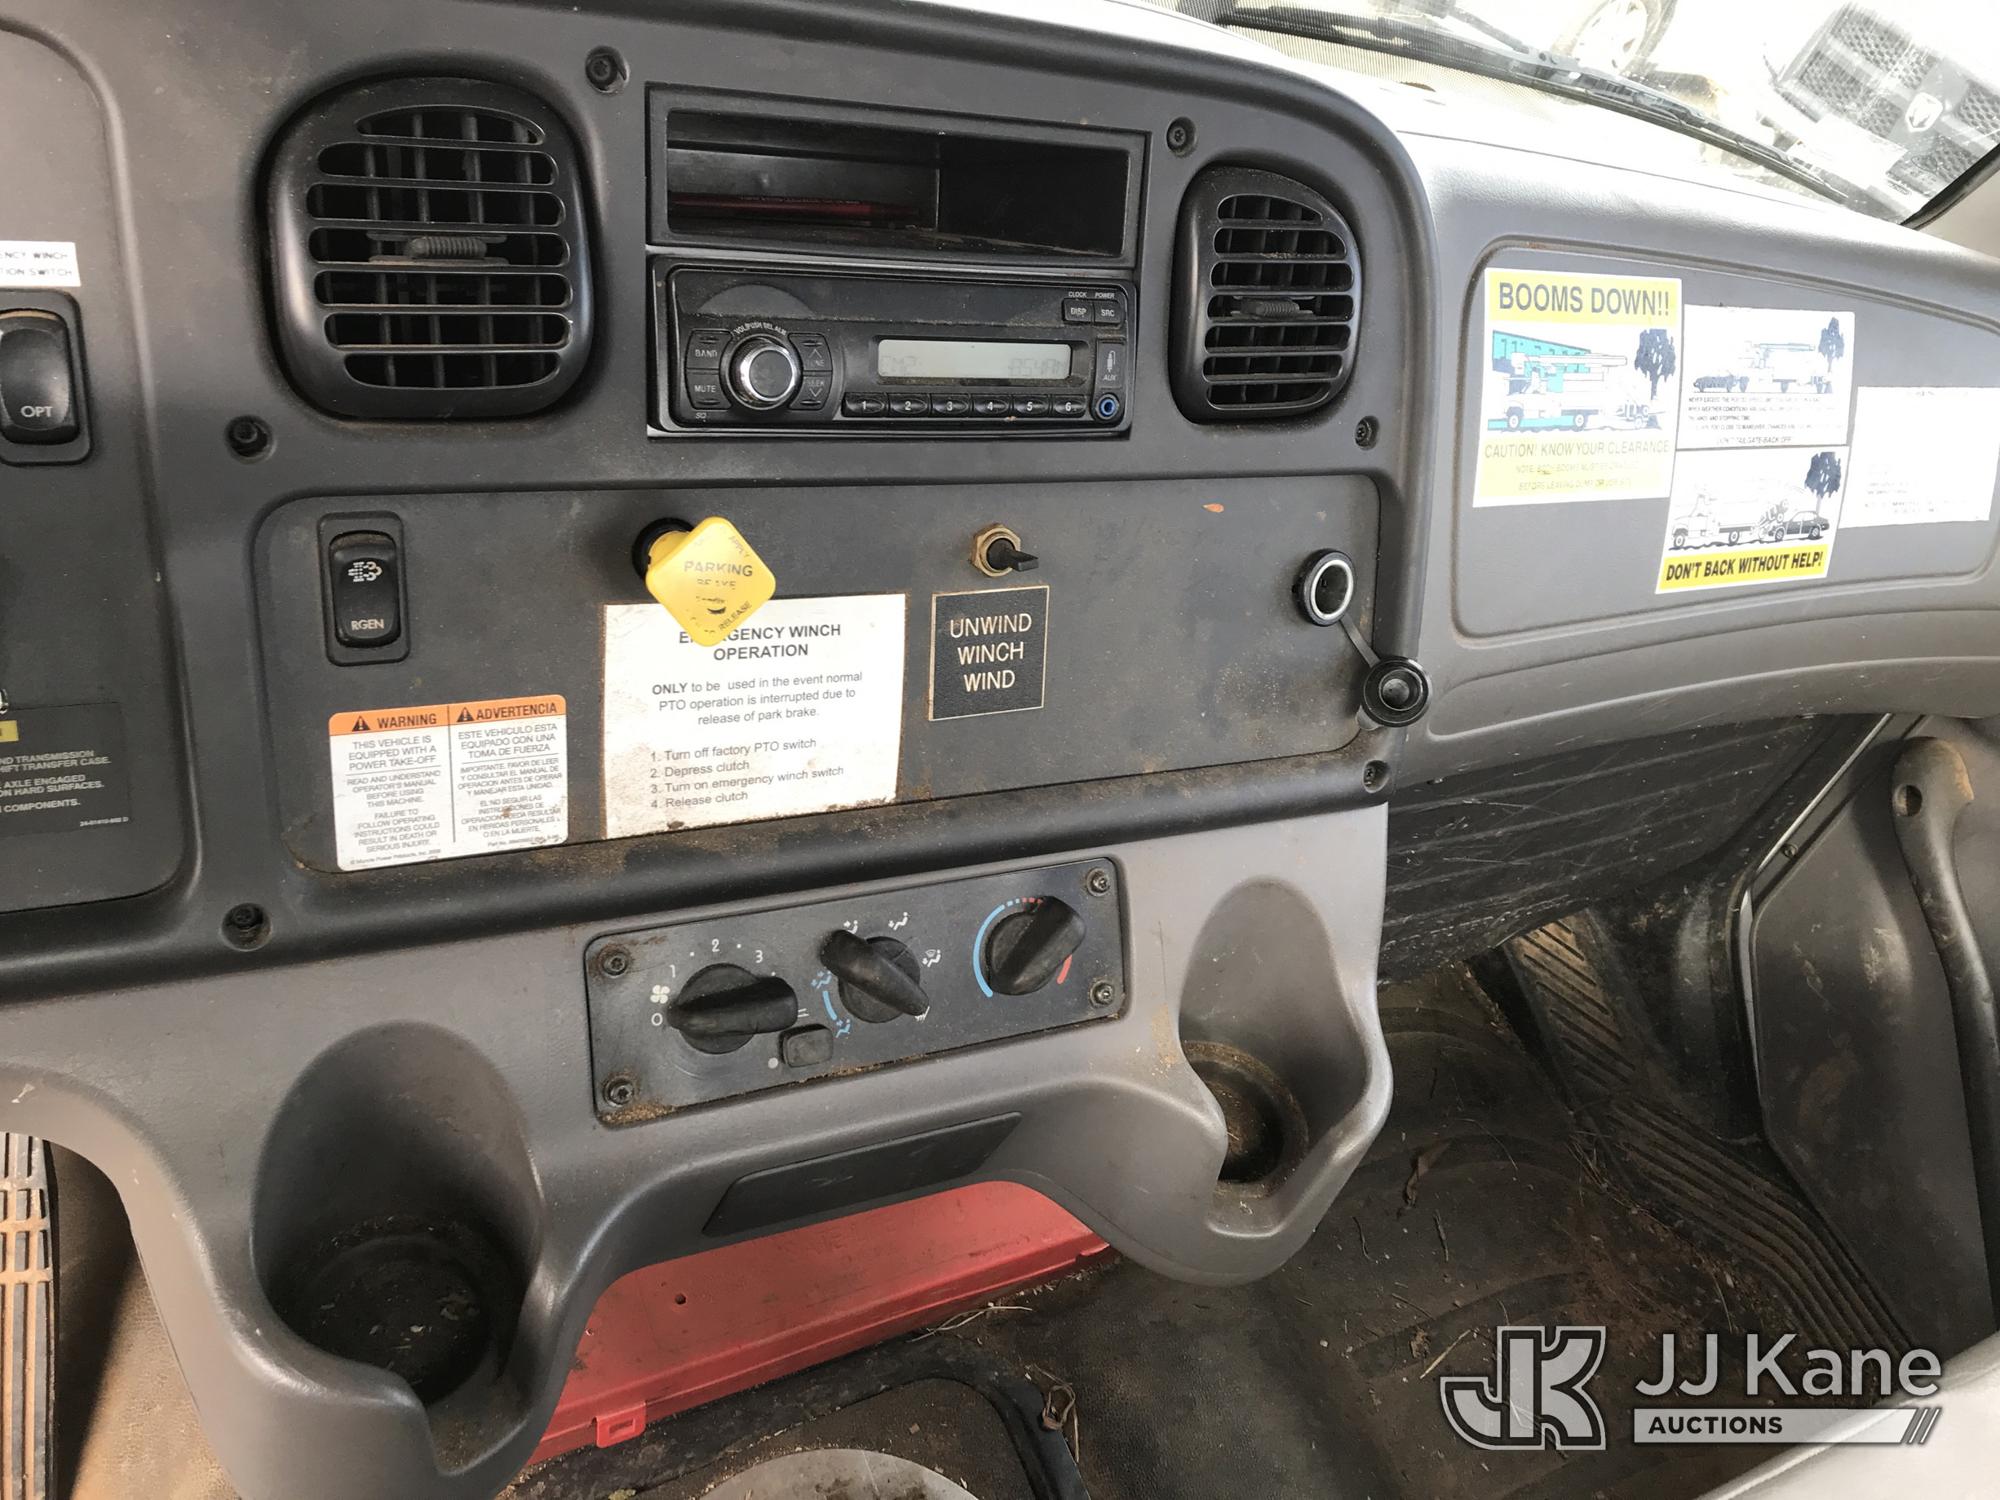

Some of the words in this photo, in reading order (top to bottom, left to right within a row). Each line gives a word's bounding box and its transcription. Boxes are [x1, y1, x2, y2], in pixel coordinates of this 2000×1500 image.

[1500, 282, 1583, 313] BOOMS
[1592, 287, 1669, 316] DOWN!!
[1071, 307, 1087, 315] DISP
[695, 350, 718, 358] BAND
[695, 385, 717, 393] MUTE
[21, 405, 53, 418] OPT
[1541, 443, 1574, 457] KNOW
[1576, 442, 1605, 456] YOUR
[685, 561, 753, 577] PARKING
[1666, 562, 1702, 581] DON'T
[1704, 558, 1736, 577] BACK
[1736, 554, 1790, 575] WITHOUT
[1791, 551, 1823, 570] HELP!
[719, 601, 752, 631] RELEASE
[352, 619, 384, 631] RGEN
[950, 613, 1032, 639] UNWIND
[679, 627, 785, 645] EGENCY
[789, 624, 842, 639] WINCH
[713, 644, 809, 661] OPERATION
[958, 641, 1024, 666] WINCH
[652, 682, 688, 696] ONLY
[692, 682, 703, 693] to
[706, 680, 721, 692] be
[728, 679, 755, 690] used
[759, 678, 769, 688] in
[773, 677, 790, 687] the
[793, 674, 823, 686] event
[826, 672, 863, 684] normal
[964, 670, 1016, 693] WIND
[659, 700, 686, 712] PTO
[690, 696, 744, 713] operation
[748, 695, 757, 706] is
[760, 690, 820, 706] interrupted
[823, 689, 843, 701] due
[846, 688, 856, 699] to
[477, 702, 558, 720] ADVERTENCIA
[698, 713, 741, 726] release
[744, 711, 755, 722] of
[758, 709, 783, 724] park
[786, 706, 820, 719] brake.
[377, 714, 437, 729] WARNING
[458, 730, 483, 740] ESTE
[484, 726, 533, 738] VEHICULO
[535, 723, 558, 733] ESTA
[353, 740, 376, 750] THIS
[378, 736, 420, 747] VEHICLE
[422, 735, 432, 743] IS
[461, 738, 511, 750] EQUIPADO
[512, 735, 534, 745] CON
[536, 733, 556, 742] UNA
[16, 750, 94, 764] TRANSMISSION
[349, 749, 400, 761] EQUIPPED
[402, 746, 427, 755] WITH
[429, 745, 437, 753] A
[468, 749, 497, 759] TOMA
[499, 748, 512, 756] DE
[513, 743, 551, 755] FUERZA
[651, 753, 661, 763] 1.
[665, 750, 691, 762] Turn
[695, 747, 710, 759] off
[712, 745, 751, 759] factory
[754, 741, 780, 753] PTO
[783, 738, 817, 751] switch
[23, 759, 79, 771] TRANSFER
[80, 757, 112, 766] CASE.
[349, 760, 387, 771] POWER
[389, 755, 437, 767] TAKE-OFF
[507, 761, 530, 769] FAVOR
[520, 766, 548, 775] MANUAL
[651, 769, 661, 779] 2.
[665, 762, 713, 779] Depress
[716, 760, 750, 773] clutch
[4, 779, 32, 789] AXLE
[34, 774, 86, 786] ENGAGED
[347, 778, 369, 786] READ
[389, 770, 441, 781] UNDERSTAND
[500, 777, 523, 785] ANTES
[651, 785, 662, 794] 3.
[665, 782, 691, 793] Turn
[695, 781, 709, 790] on
[712, 774, 774, 789] emergency
[778, 769, 809, 782] winch
[812, 766, 845, 779] switch
[14, 786, 45, 796] HARD
[47, 781, 105, 792] SURFACES.
[352, 782, 402, 793] OPERATOR'S
[404, 779, 437, 788] MANUAL
[474, 786, 508, 796] MANEJAR
[367, 791, 398, 800] BEFORE
[400, 788, 424, 797] USING
[665, 796, 712, 808] Release
[715, 791, 749, 803] clutch
[4, 799, 81, 813] COMPONENTS.
[368, 800, 386, 808] THIS
[358, 820, 391, 830] FOLLOW
[393, 815, 436, 826] OPERATING
[375, 810, 407, 820] FAILURE
[354, 826, 412, 838] INSTRUCTIONS
[413, 822, 441, 830] COULD
[359, 836, 388, 846] RESULT
[400, 832, 424, 841] DEATH
[426, 830, 438, 838] OR
[367, 843, 400, 853] SERIOUS
[712, 939, 720, 953] 2
[755, 950, 764, 964] 3
[670, 965, 676, 978] 1
